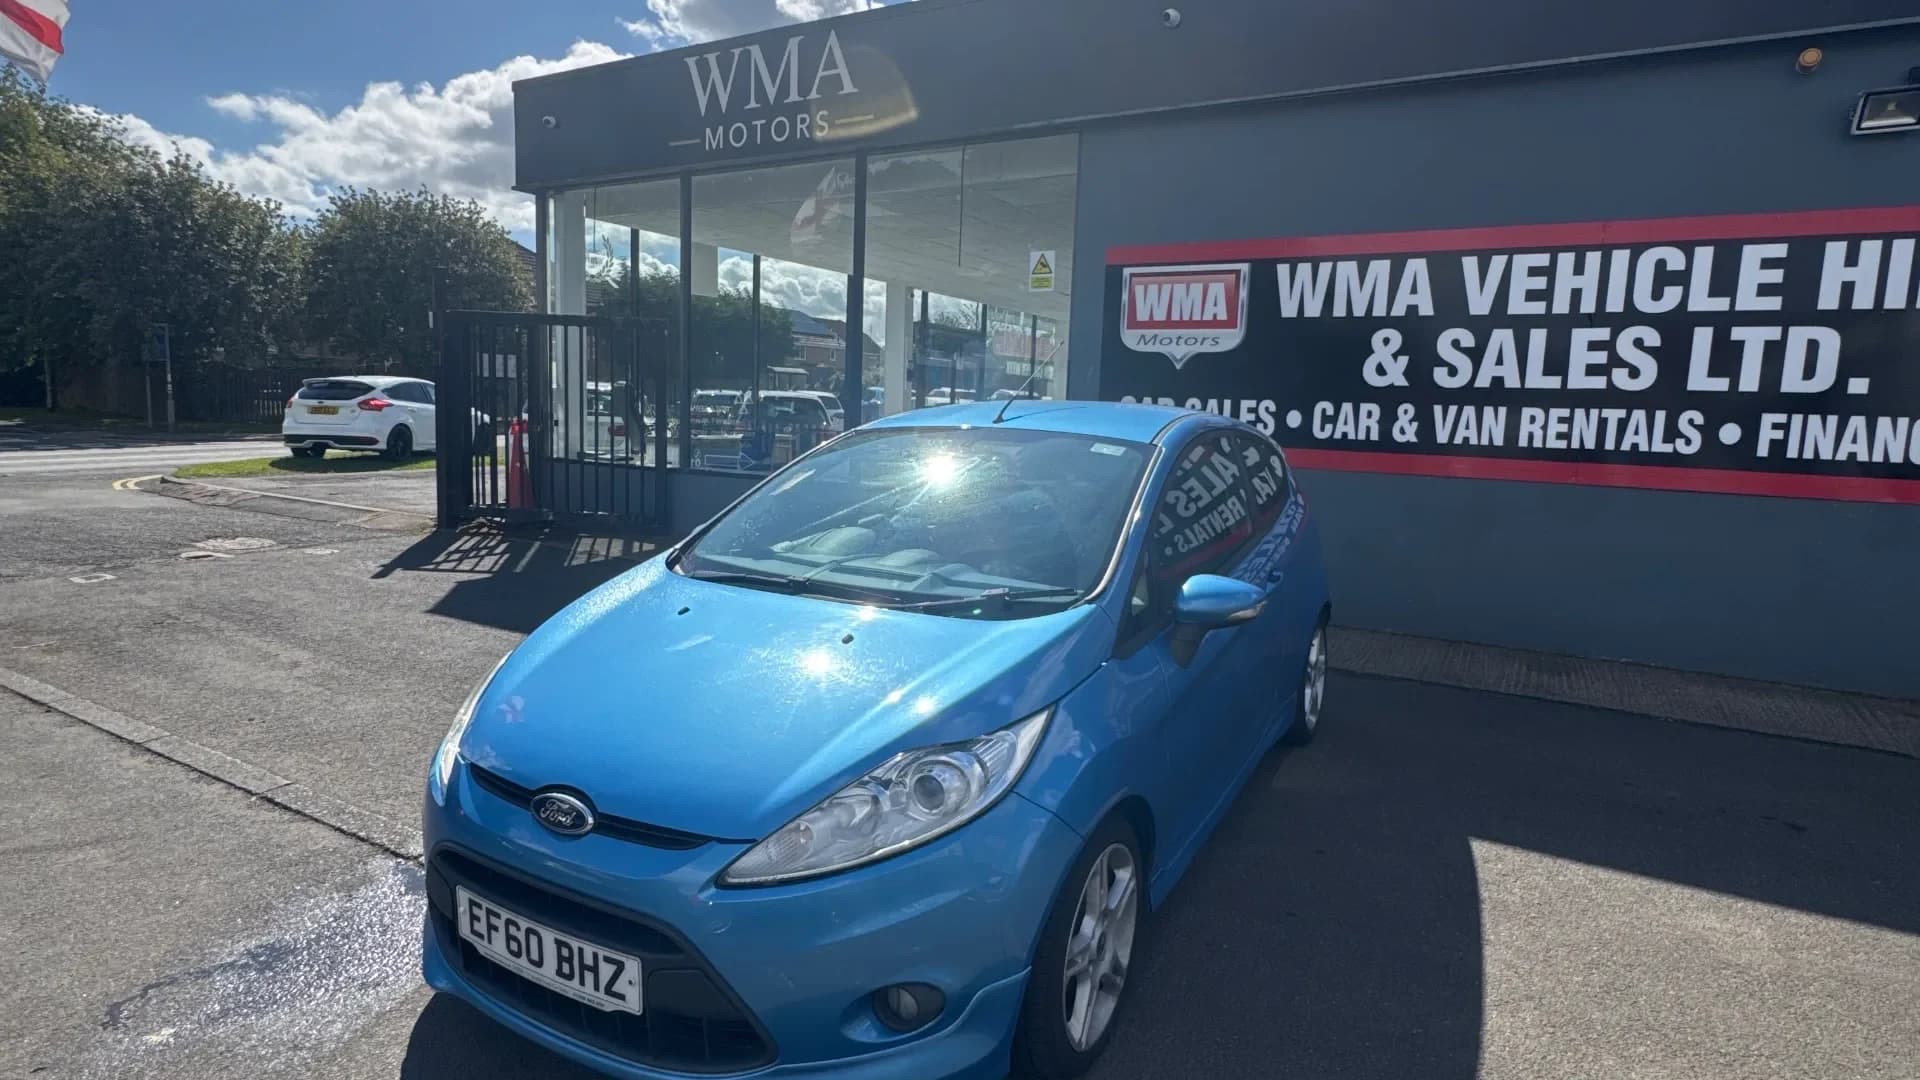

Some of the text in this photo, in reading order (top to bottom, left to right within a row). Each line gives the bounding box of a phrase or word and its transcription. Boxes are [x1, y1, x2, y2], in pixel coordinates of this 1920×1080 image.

[684, 29, 859, 117] WMA
[705, 110, 829, 151] MOTORS
[1135, 282, 1228, 321] WMA
[1277, 238, 1920, 318] WMA VEHICLE HI
[1136, 334, 1220, 346] Motors
[1362, 325, 1871, 394] & SALES LTD.
[1312, 401, 1381, 441] CAR
[1391, 403, 1419, 443] &
[1433, 405, 1508, 448] VAN
[1518, 407, 1705, 455] RENTALS
[540, 799, 577, 826] Ford
[467, 897, 545, 969] EF60
[554, 937, 627, 1002] BHZ
